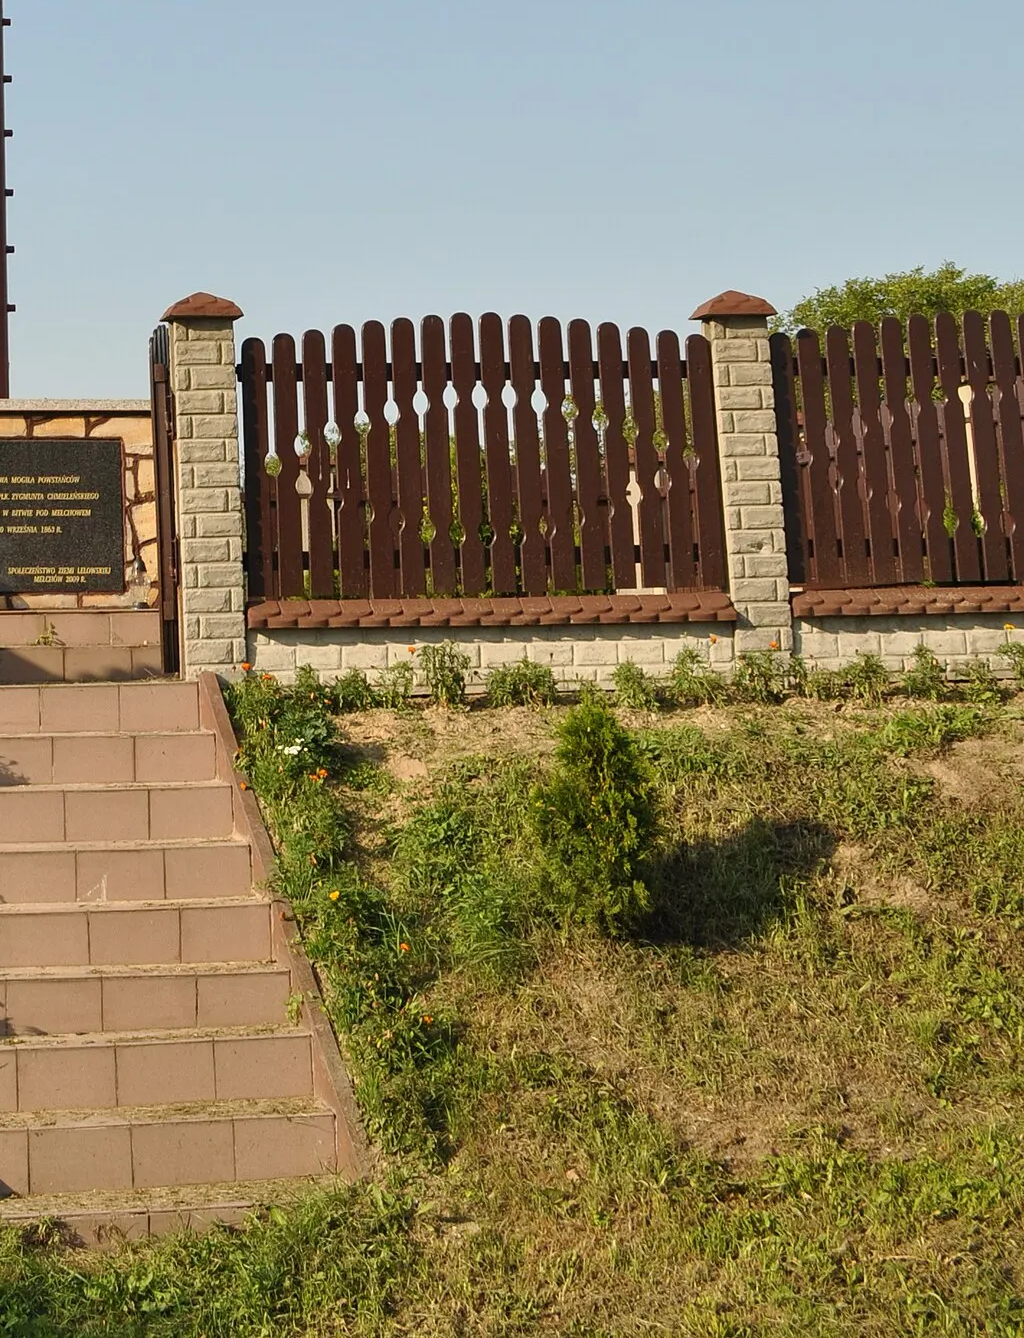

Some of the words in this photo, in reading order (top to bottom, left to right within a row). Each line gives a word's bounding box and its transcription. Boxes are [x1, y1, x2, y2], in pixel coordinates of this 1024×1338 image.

[12, 493, 44, 501] ZYGMUNTA
[2, 509, 9, 517] W
[12, 509, 33, 517] BITWIE
[36, 509, 49, 517] POD
[7, 524, 38, 534] WRZEŚNIA
[41, 526, 56, 534] 1863
